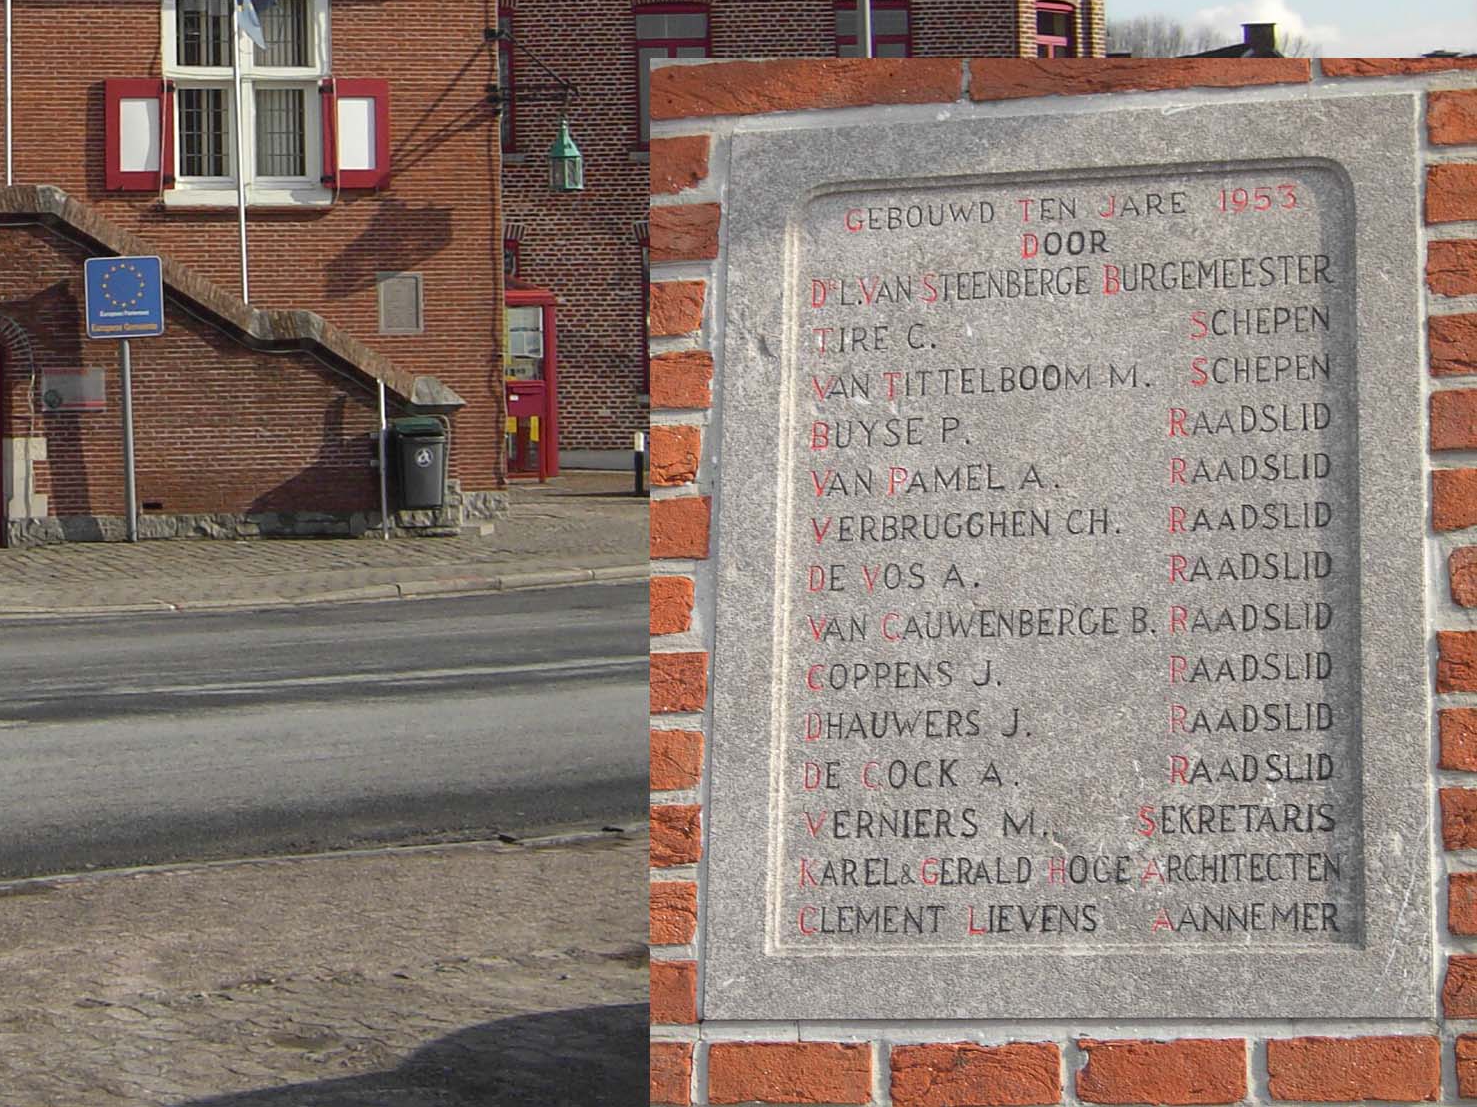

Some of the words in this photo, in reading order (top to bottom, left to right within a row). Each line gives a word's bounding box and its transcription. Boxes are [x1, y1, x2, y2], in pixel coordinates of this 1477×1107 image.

[844, 202, 995, 232] GEBOUWD
[1017, 197, 1078, 222] TEN
[1099, 192, 1187, 219] JARE
[1218, 184, 1298, 214] 1953
[1021, 229, 1110, 259] DOOR
[917, 266, 1090, 304] STEENBERGE
[1102, 254, 1334, 296] BURGEMEESTER
[812, 325, 889, 353] TIRE
[907, 323, 937, 350] C.
[1189, 305, 1330, 340] SCHEPEN
[811, 373, 869, 401] VAN
[883, 365, 1092, 402] TITTELBOOM
[1108, 364, 1151, 389] M.
[1190, 353, 1330, 388] SCHEPEN
[810, 416, 924, 451] BUYSE
[941, 416, 971, 445] P.
[1168, 402, 1331, 437] RAADSLID
[810, 468, 873, 497] VAN
[887, 463, 1005, 496] PAMEL
[1019, 464, 1060, 490] A.
[1169, 453, 1332, 485] RAADSLID
[811, 510, 1050, 544] VERBRUGGHEN
[1066, 508, 1121, 535] CH.
[1169, 502, 1332, 534] RAADSLID
[808, 564, 845, 593] DE
[862, 562, 925, 594] VOS
[942, 564, 979, 589] A.
[1169, 551, 1332, 583] RAADSLID
[807, 614, 866, 642] VAN
[881, 607, 1119, 641] CAUWENBERGE
[1131, 606, 1157, 634] B.
[1169, 602, 1332, 634] RAADSLID
[807, 660, 953, 691] COPPENS
[972, 660, 1001, 687] J.
[1169, 652, 1332, 684] RAADSLID
[805, 710, 980, 741] DHAUWERS
[1001, 708, 1032, 737] J.
[1169, 703, 1334, 733] RAADSLID
[803, 762, 841, 791] DE
[861, 759, 959, 789] COCK
[980, 762, 1020, 787] A.
[1170, 753, 1334, 785] RAADSLID
[804, 808, 978, 839] VERNIERS
[1002, 810, 1049, 838] M.
[1137, 803, 1335, 837] SEKRETARIS
[920, 856, 1032, 887] GERALD
[1047, 854, 1131, 885] HOGE
[1141, 852, 1341, 886] ARCHITECTEN
[797, 905, 945, 936] CLEMENT
[967, 904, 1098, 935] LIEVENS
[1151, 902, 1341, 934] AANNEMER
